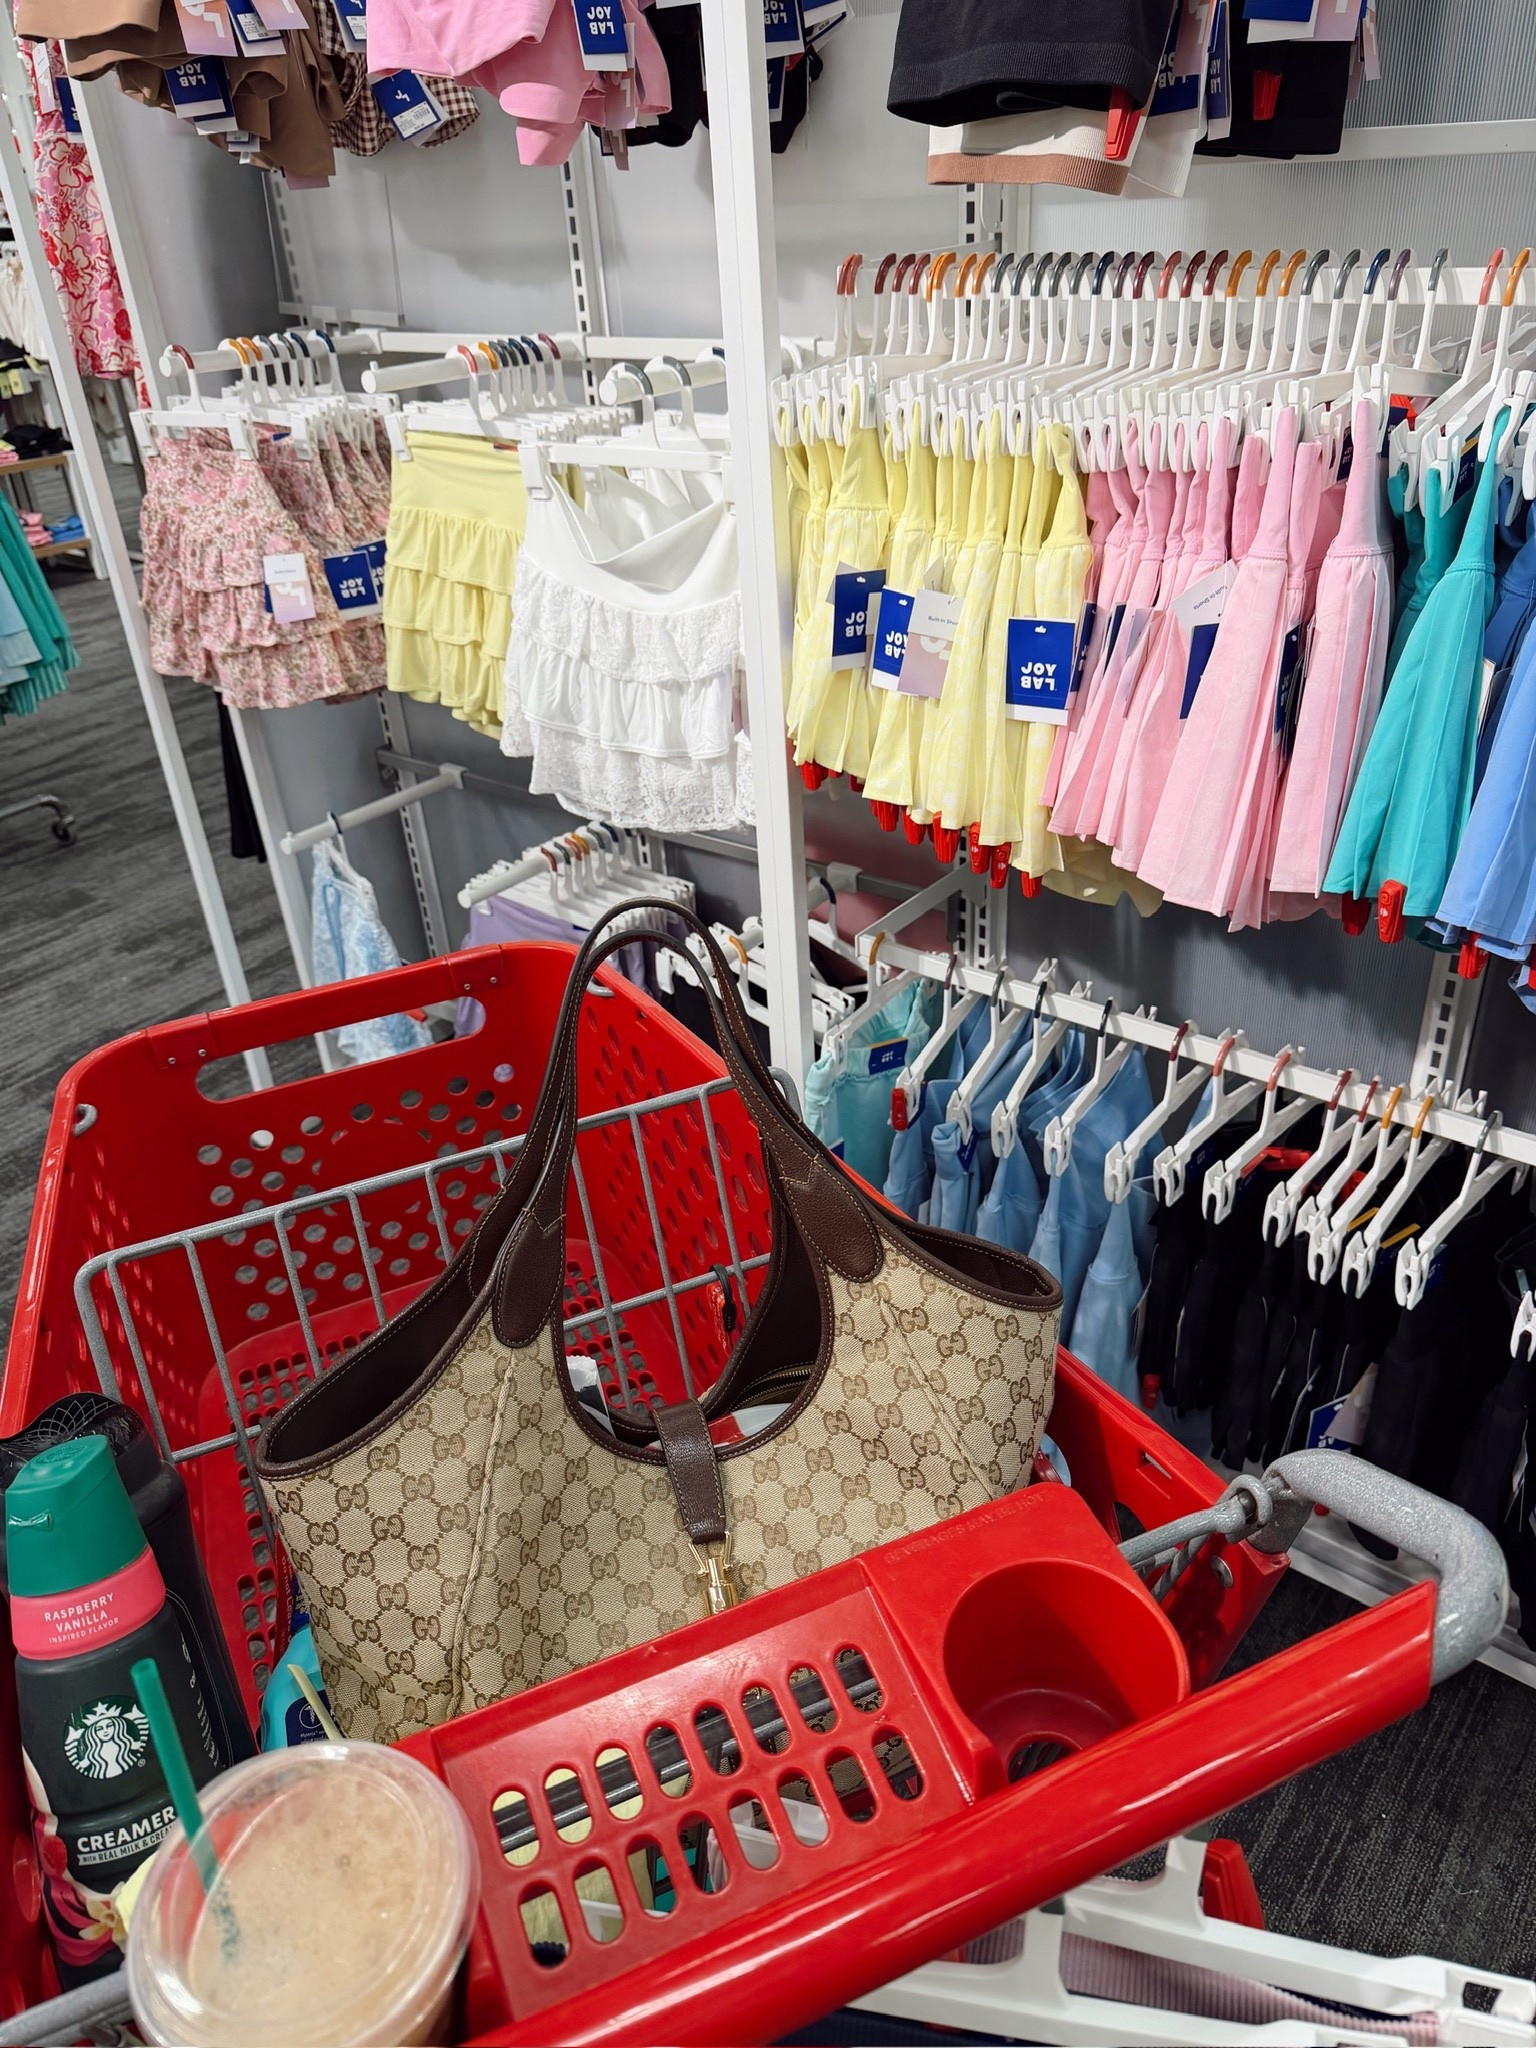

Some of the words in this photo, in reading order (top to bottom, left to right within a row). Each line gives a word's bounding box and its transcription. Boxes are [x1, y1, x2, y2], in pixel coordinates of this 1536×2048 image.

[587, 6, 611, 20] JOY
[589, 21, 615, 35] LAB
[176, 62, 202, 75] JOY
[179, 74, 206, 87] LAB
[1158, 72, 1187, 88] AB
[339, 577, 363, 589] JOY
[341, 587, 366, 599] LAB
[845, 611, 868, 625] JO
[845, 624, 866, 638] AB
[1021, 662, 1057, 676] JOY
[1021, 676, 1056, 691] LAB
[44, 1593, 114, 1622] RASPBERRY
[55, 1610, 108, 1633] VANILLA
[48, 1630, 86, 1644] INSPIRED
[88, 1617, 119, 1637] FLAVOR
[77, 1805, 177, 1853] CREAMER
[98, 1850, 118, 1862] REAL
[120, 1842, 140, 1856] MILK
[142, 1839, 149, 1848] &
